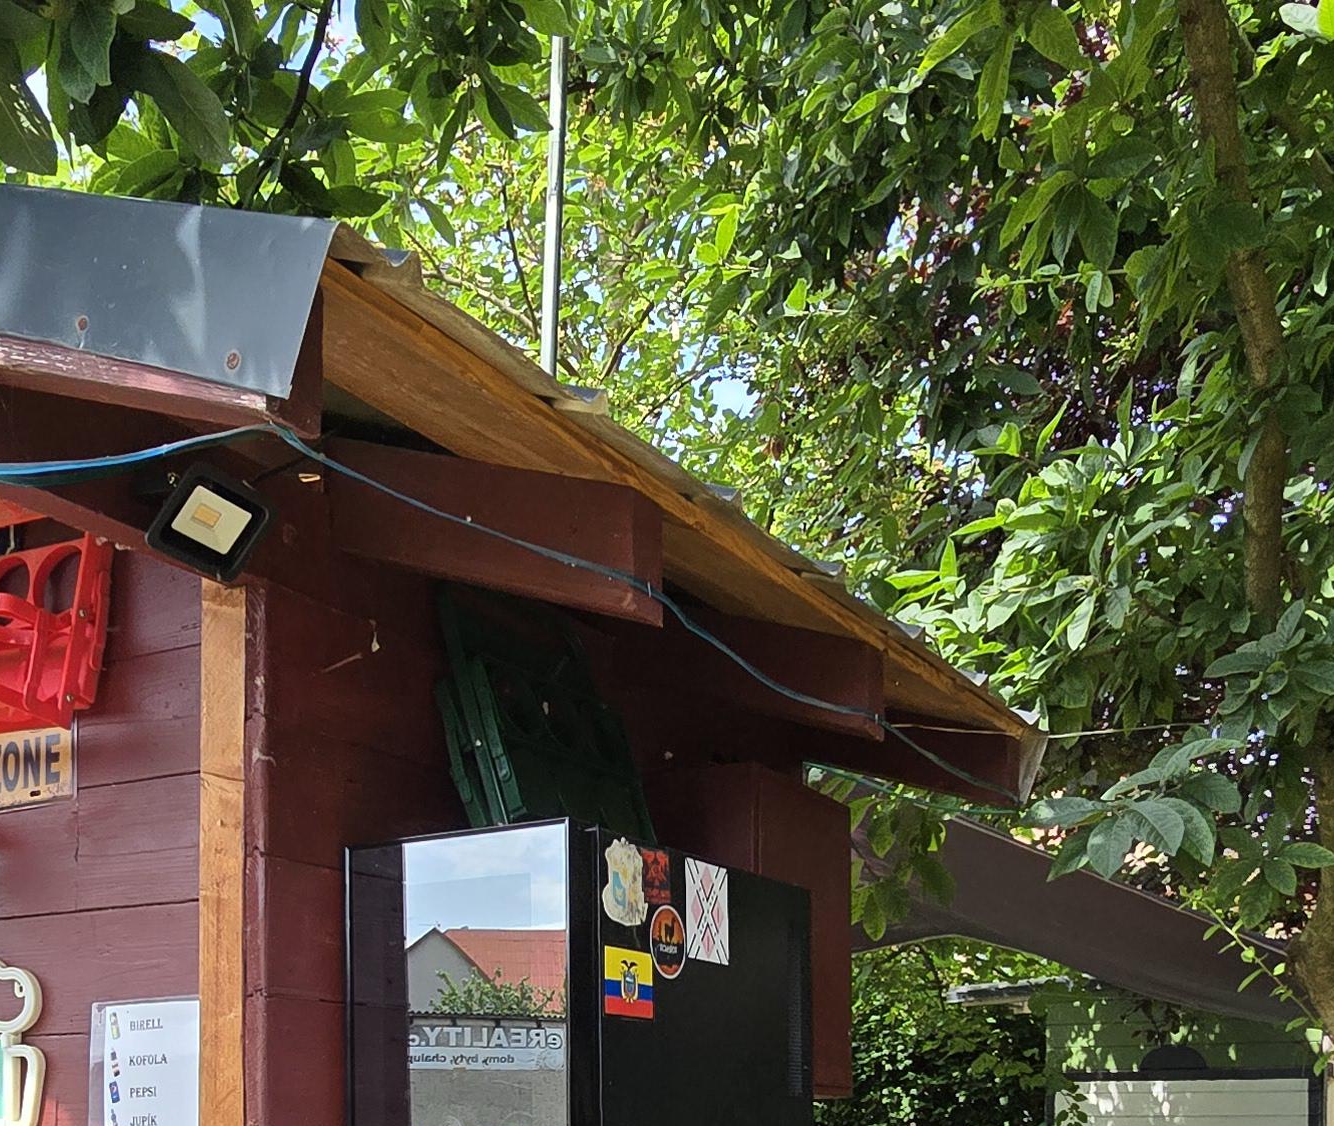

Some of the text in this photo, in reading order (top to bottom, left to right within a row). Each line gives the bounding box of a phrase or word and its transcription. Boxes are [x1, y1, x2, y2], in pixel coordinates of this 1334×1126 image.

[130, 1018, 163, 1031] BIRELL
[129, 1053, 168, 1066] KOFOLA
[129, 1086, 157, 1098] PEPSI
[129, 1113, 157, 1126] JUPÍK
